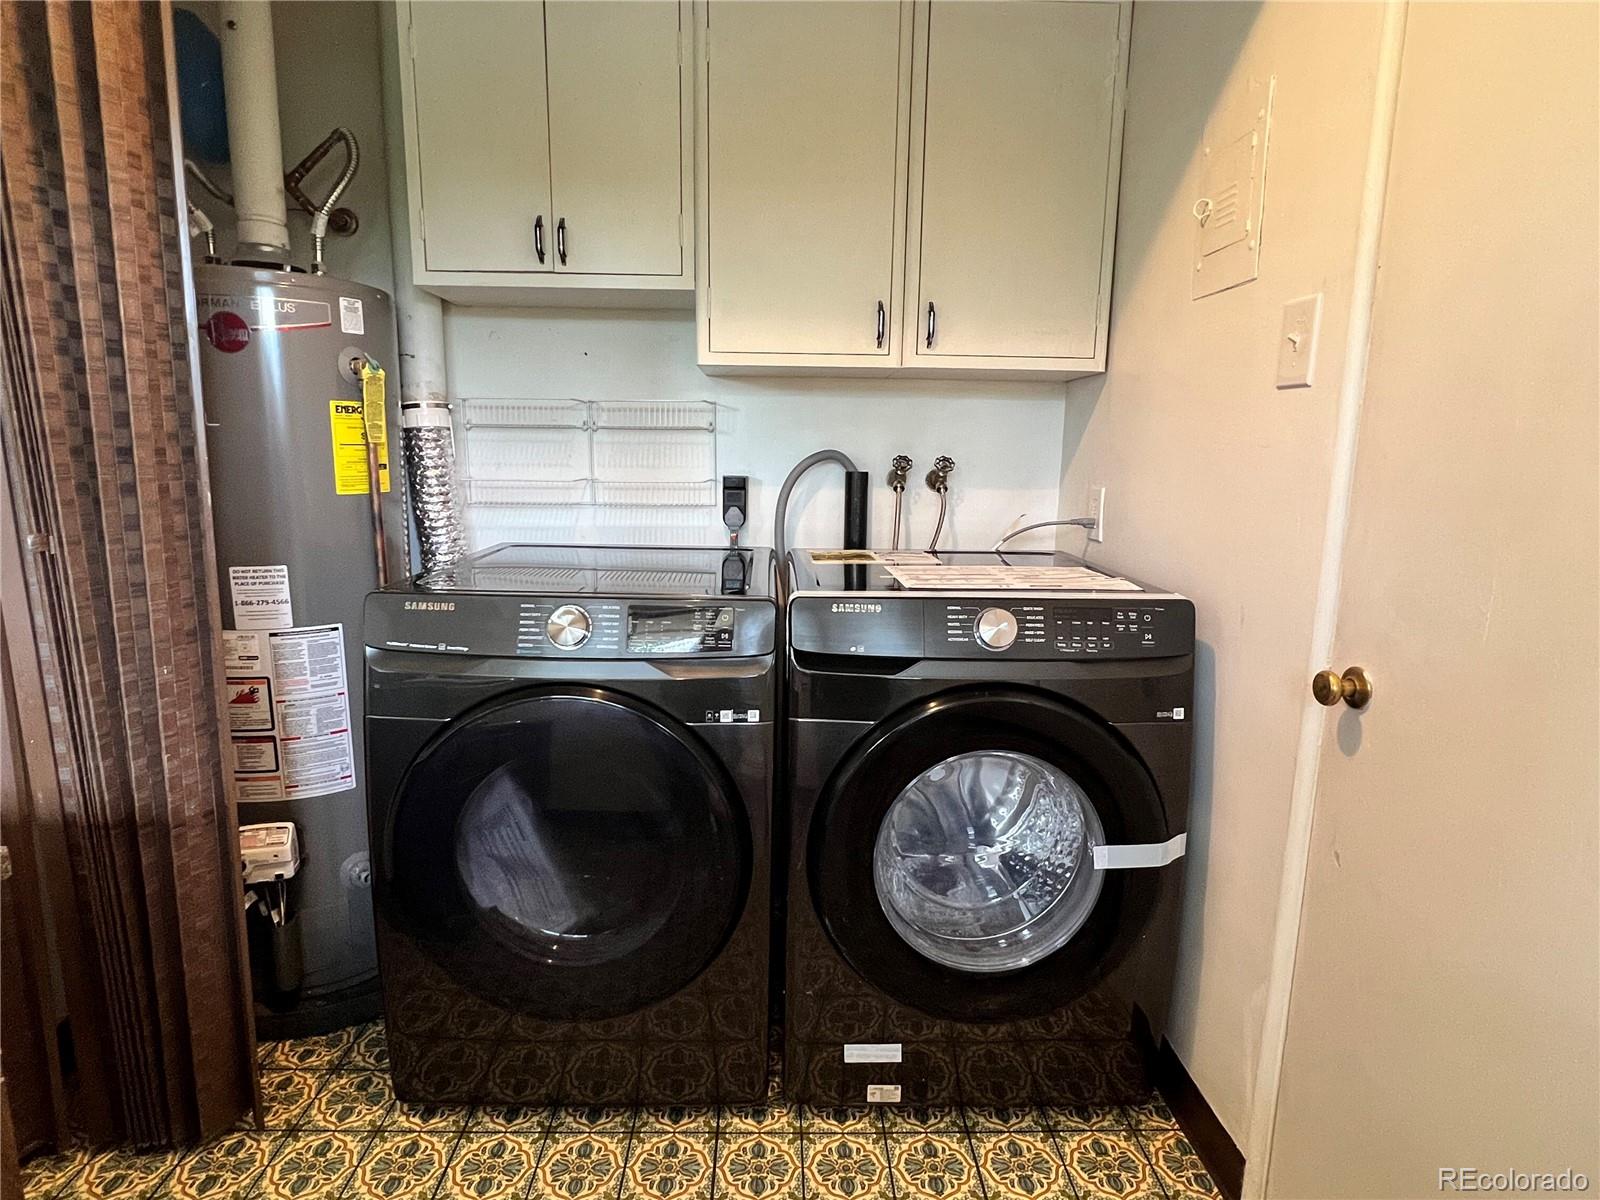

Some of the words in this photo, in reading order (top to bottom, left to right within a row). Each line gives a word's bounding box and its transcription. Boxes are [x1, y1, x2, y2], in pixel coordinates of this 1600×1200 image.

[336, 405, 363, 415] ENERG
[404, 601, 456, 611] SAMSUNG
[831, 603, 882, 613] SAMSUNG
